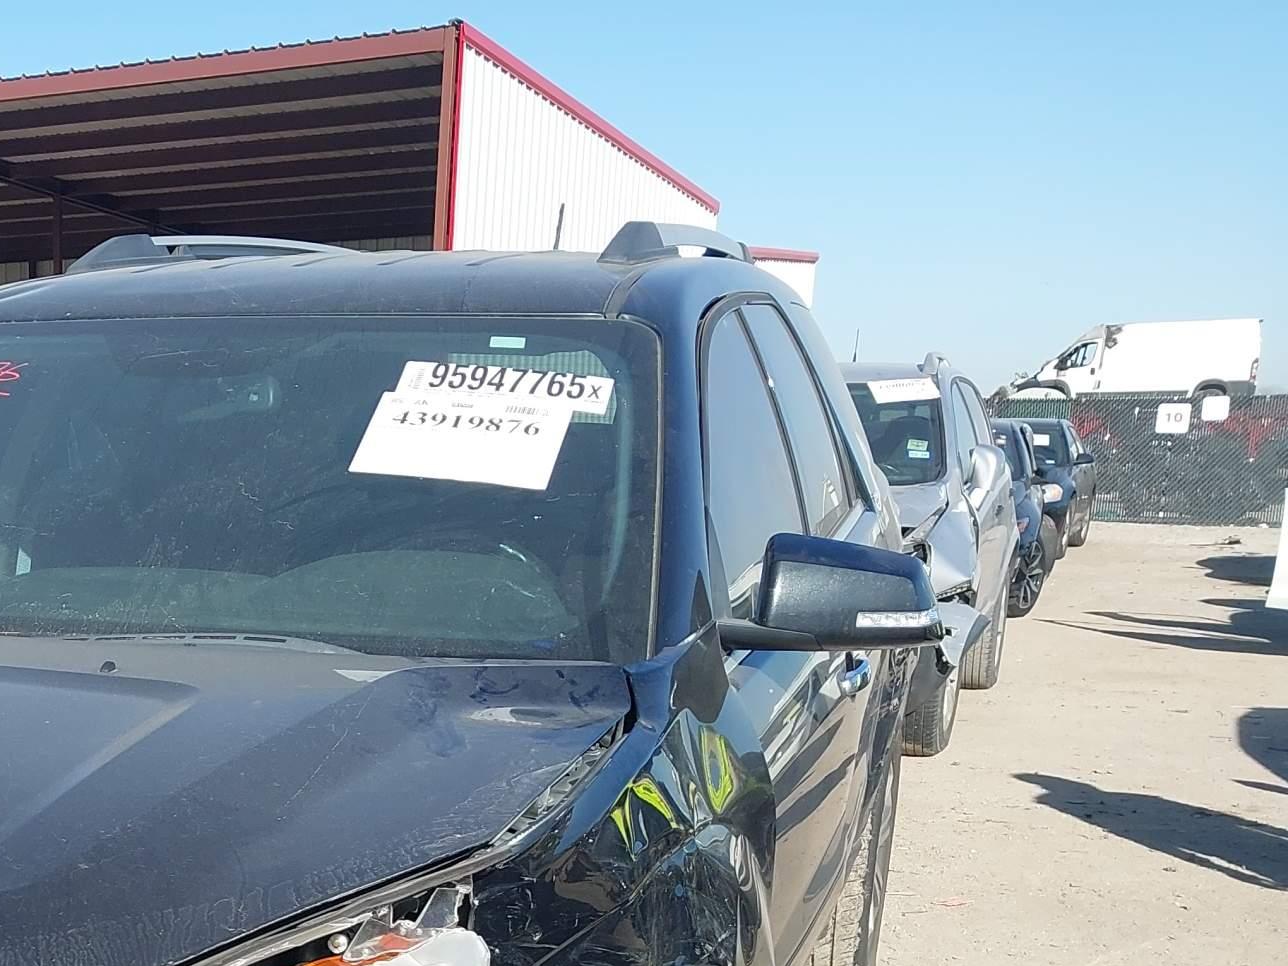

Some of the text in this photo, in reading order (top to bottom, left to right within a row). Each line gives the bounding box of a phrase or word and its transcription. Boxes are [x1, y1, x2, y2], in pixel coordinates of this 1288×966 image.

[428, 363, 587, 399] 95947765
[392, 410, 540, 436] 43919876
[1165, 412, 1183, 423] 10
